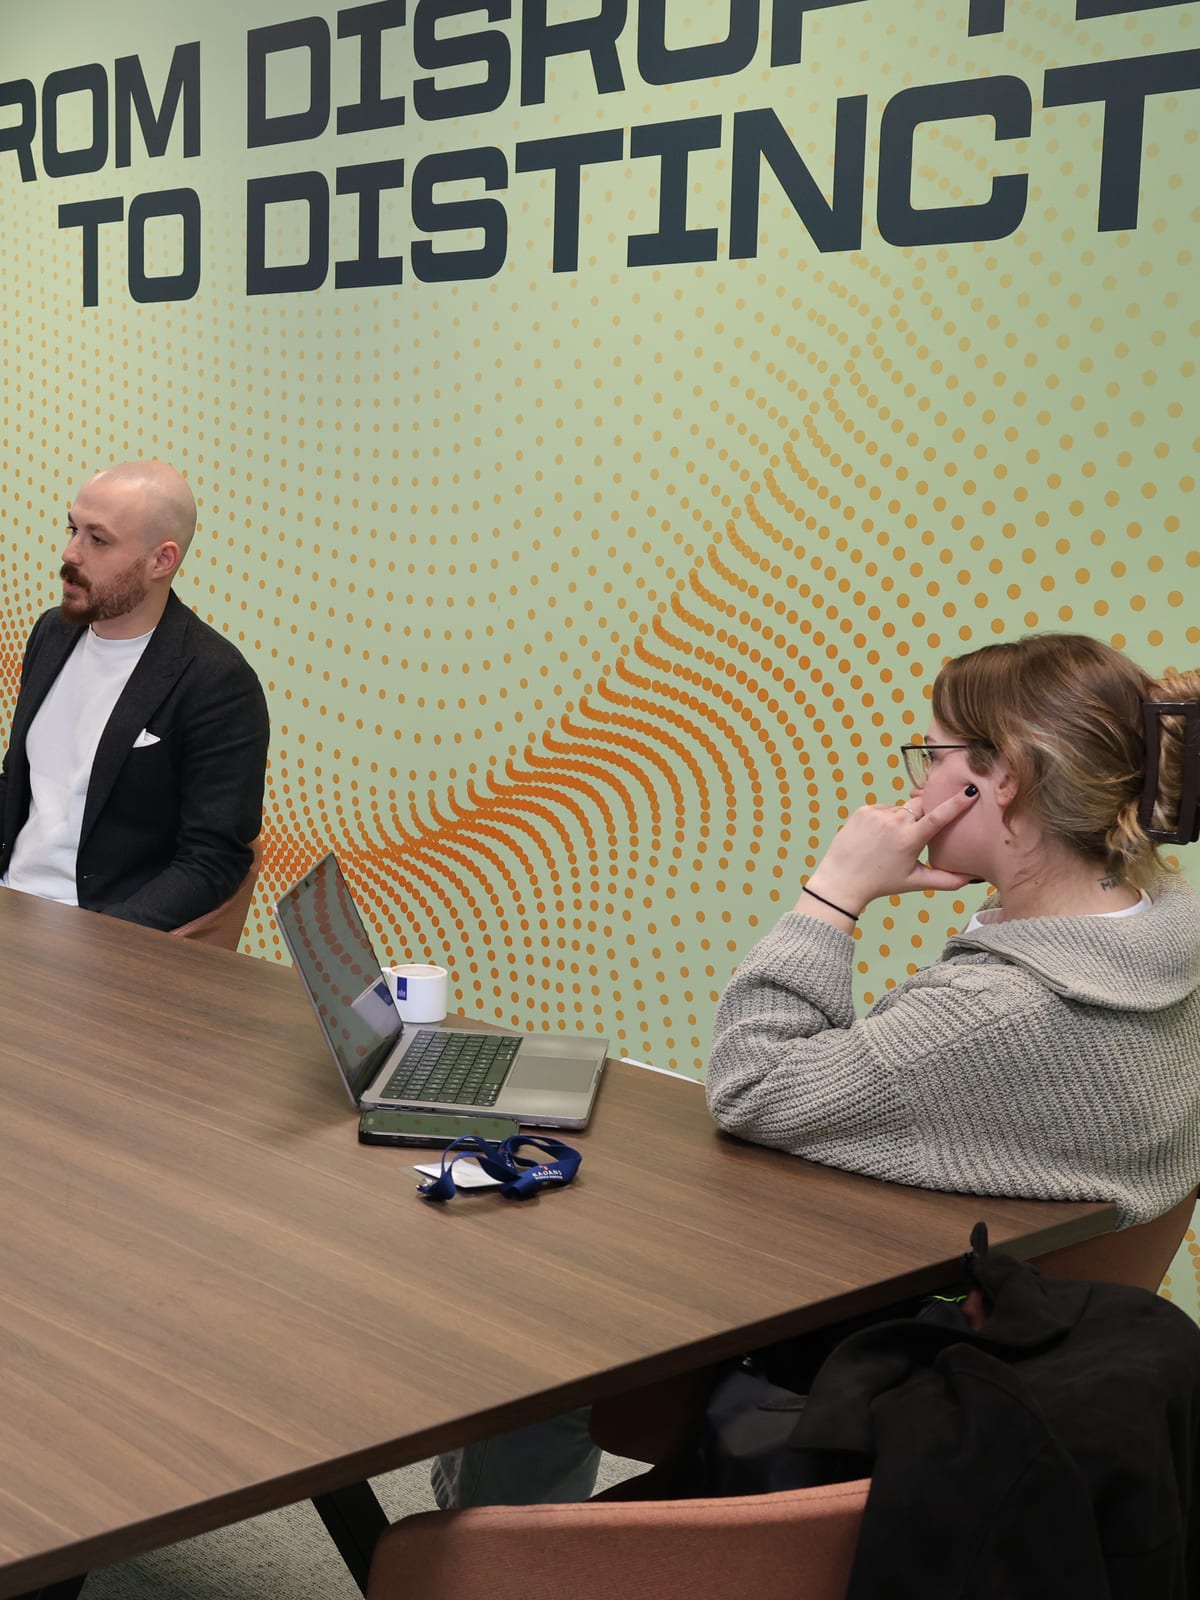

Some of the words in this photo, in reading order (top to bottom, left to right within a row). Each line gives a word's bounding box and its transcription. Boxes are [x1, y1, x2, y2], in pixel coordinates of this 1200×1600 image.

[247, 0, 1200, 149] DISRU
[58, 188, 201, 307] TO
[246, 49, 1200, 296] DISTINCT
